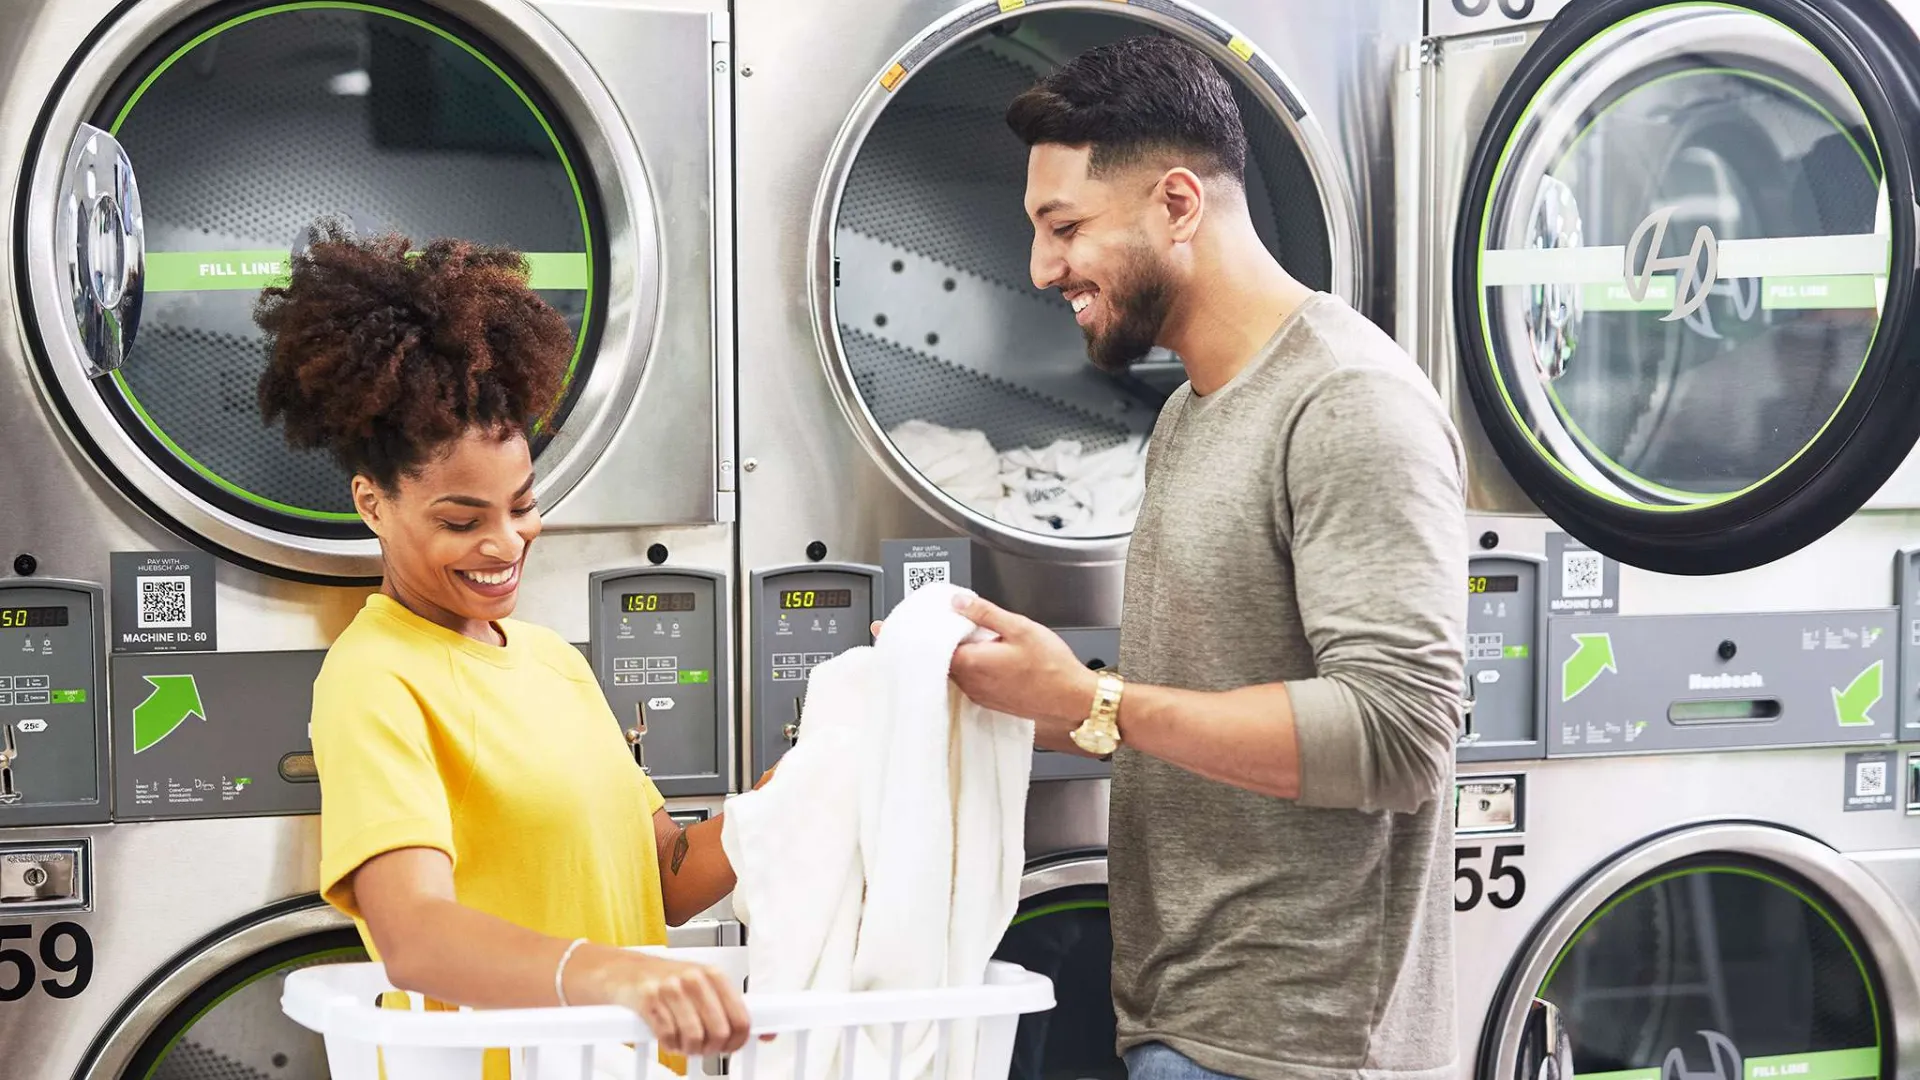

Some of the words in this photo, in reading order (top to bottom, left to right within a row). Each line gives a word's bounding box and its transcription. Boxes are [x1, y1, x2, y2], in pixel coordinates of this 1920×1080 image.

[200, 263, 237, 276] FILL
[242, 262, 281, 275] LINE
[123, 633, 174, 643] MACHINE
[177, 632, 192, 642] ID:
[194, 632, 207, 641] 60
[1455, 845, 1526, 912] 55
[0, 922, 94, 1002] 59
[1753, 1065, 1778, 1078] FILL
[1780, 1062, 1809, 1075] LINE
